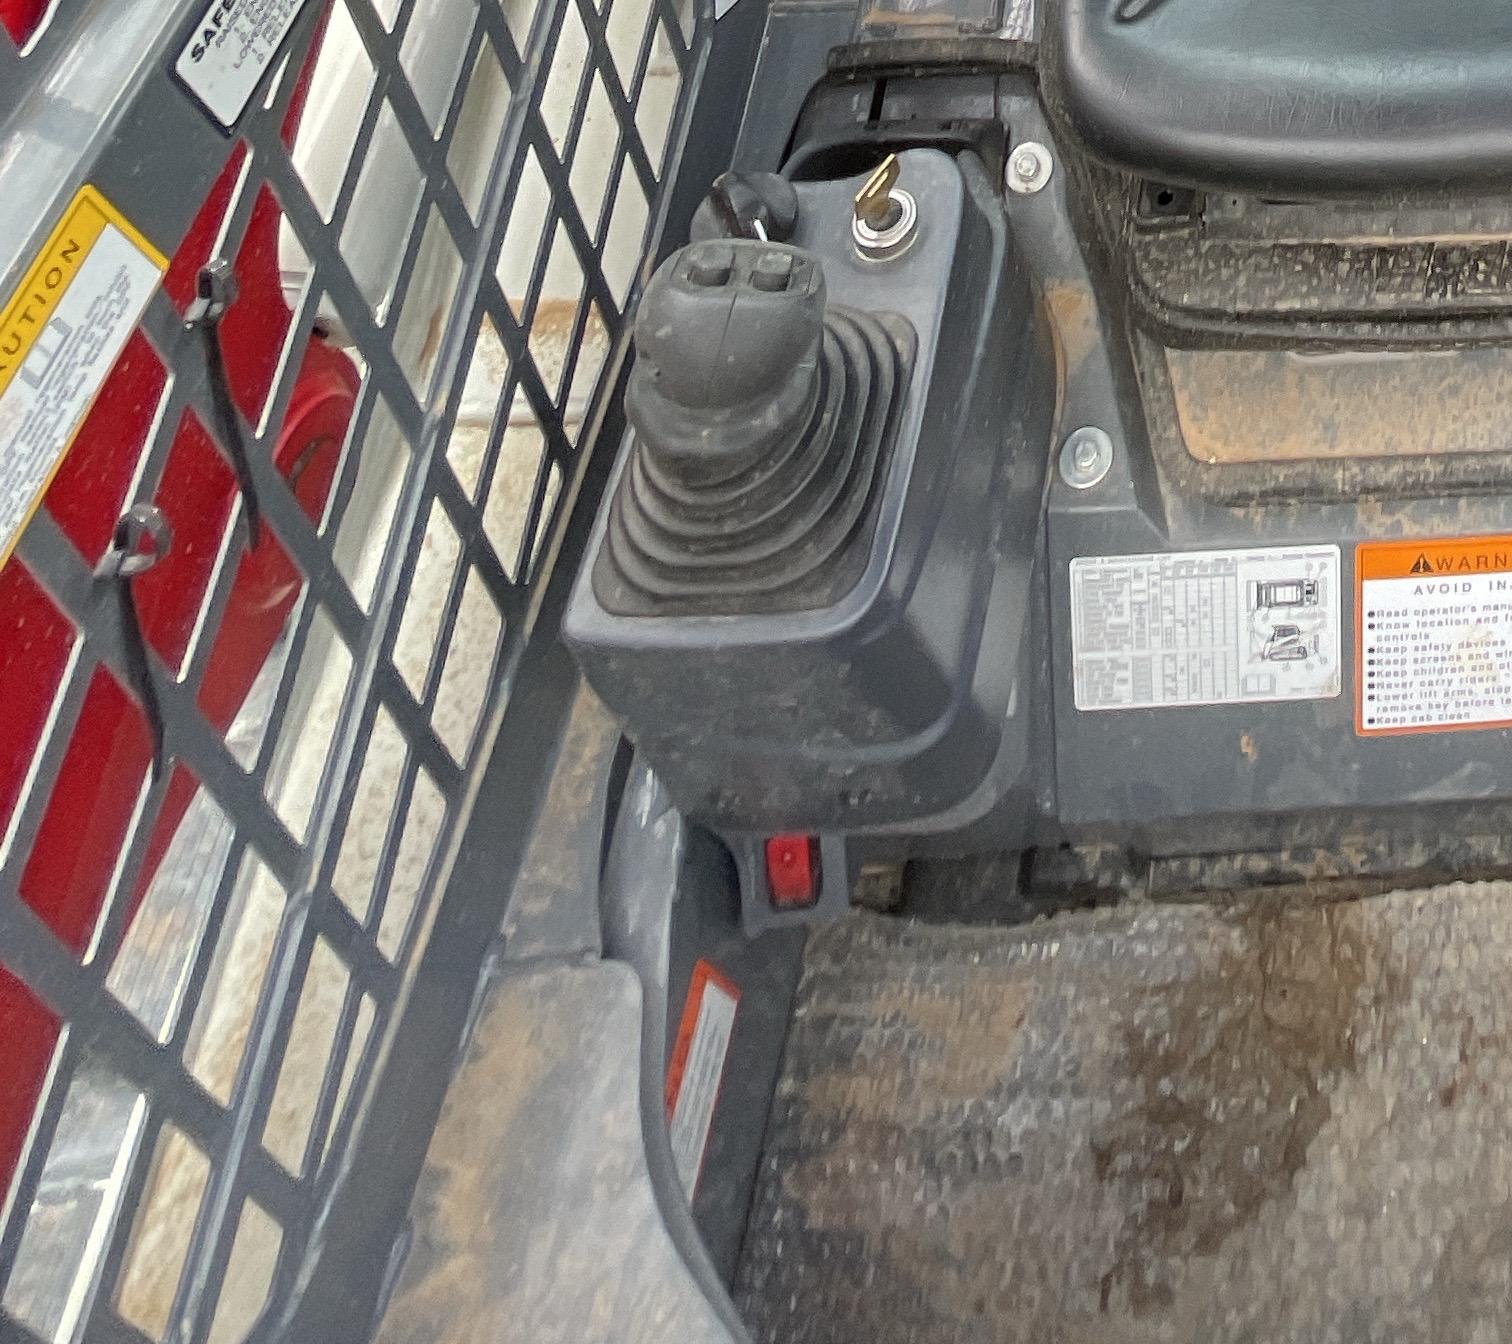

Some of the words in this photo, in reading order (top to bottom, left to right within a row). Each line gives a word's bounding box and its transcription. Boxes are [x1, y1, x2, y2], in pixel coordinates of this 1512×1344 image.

[0, 239, 80, 370] UTION
[1413, 582, 1473, 596] AVOID
[1377, 608, 1408, 618] Read
[1413, 606, 1477, 617] operator's
[1377, 622, 1410, 630] Know
[1416, 618, 1469, 628] location
[1377, 646, 1408, 655] Keep
[1377, 658, 1408, 667] Keep
[1468, 651, 1490, 660] and
[1377, 671, 1408, 680] Keep
[1413, 666, 1465, 677] children
[1471, 662, 1493, 671] and
[1377, 681, 1414, 689] Never
[1377, 692, 1414, 702] Lower
[1377, 716, 1406, 725] Keep
